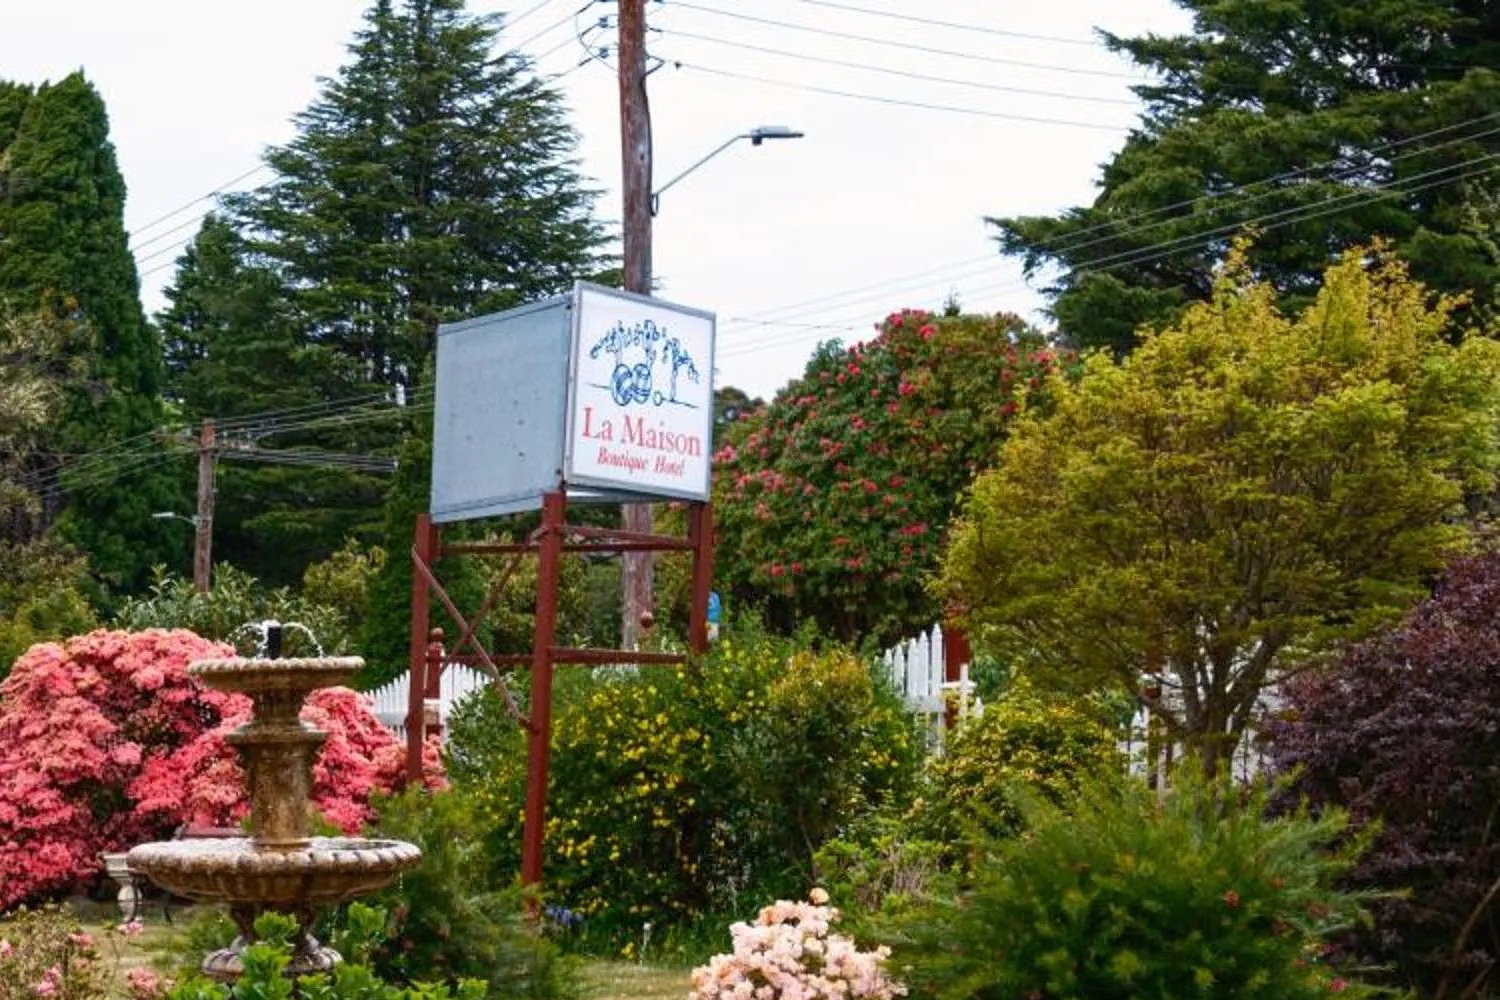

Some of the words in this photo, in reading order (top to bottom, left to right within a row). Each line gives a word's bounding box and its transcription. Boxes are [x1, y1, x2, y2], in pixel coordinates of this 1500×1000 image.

[582, 407, 613, 441] La
[620, 415, 701, 457] Maison
[597, 447, 649, 475] Boutique
[655, 455, 686, 477] Hotel
